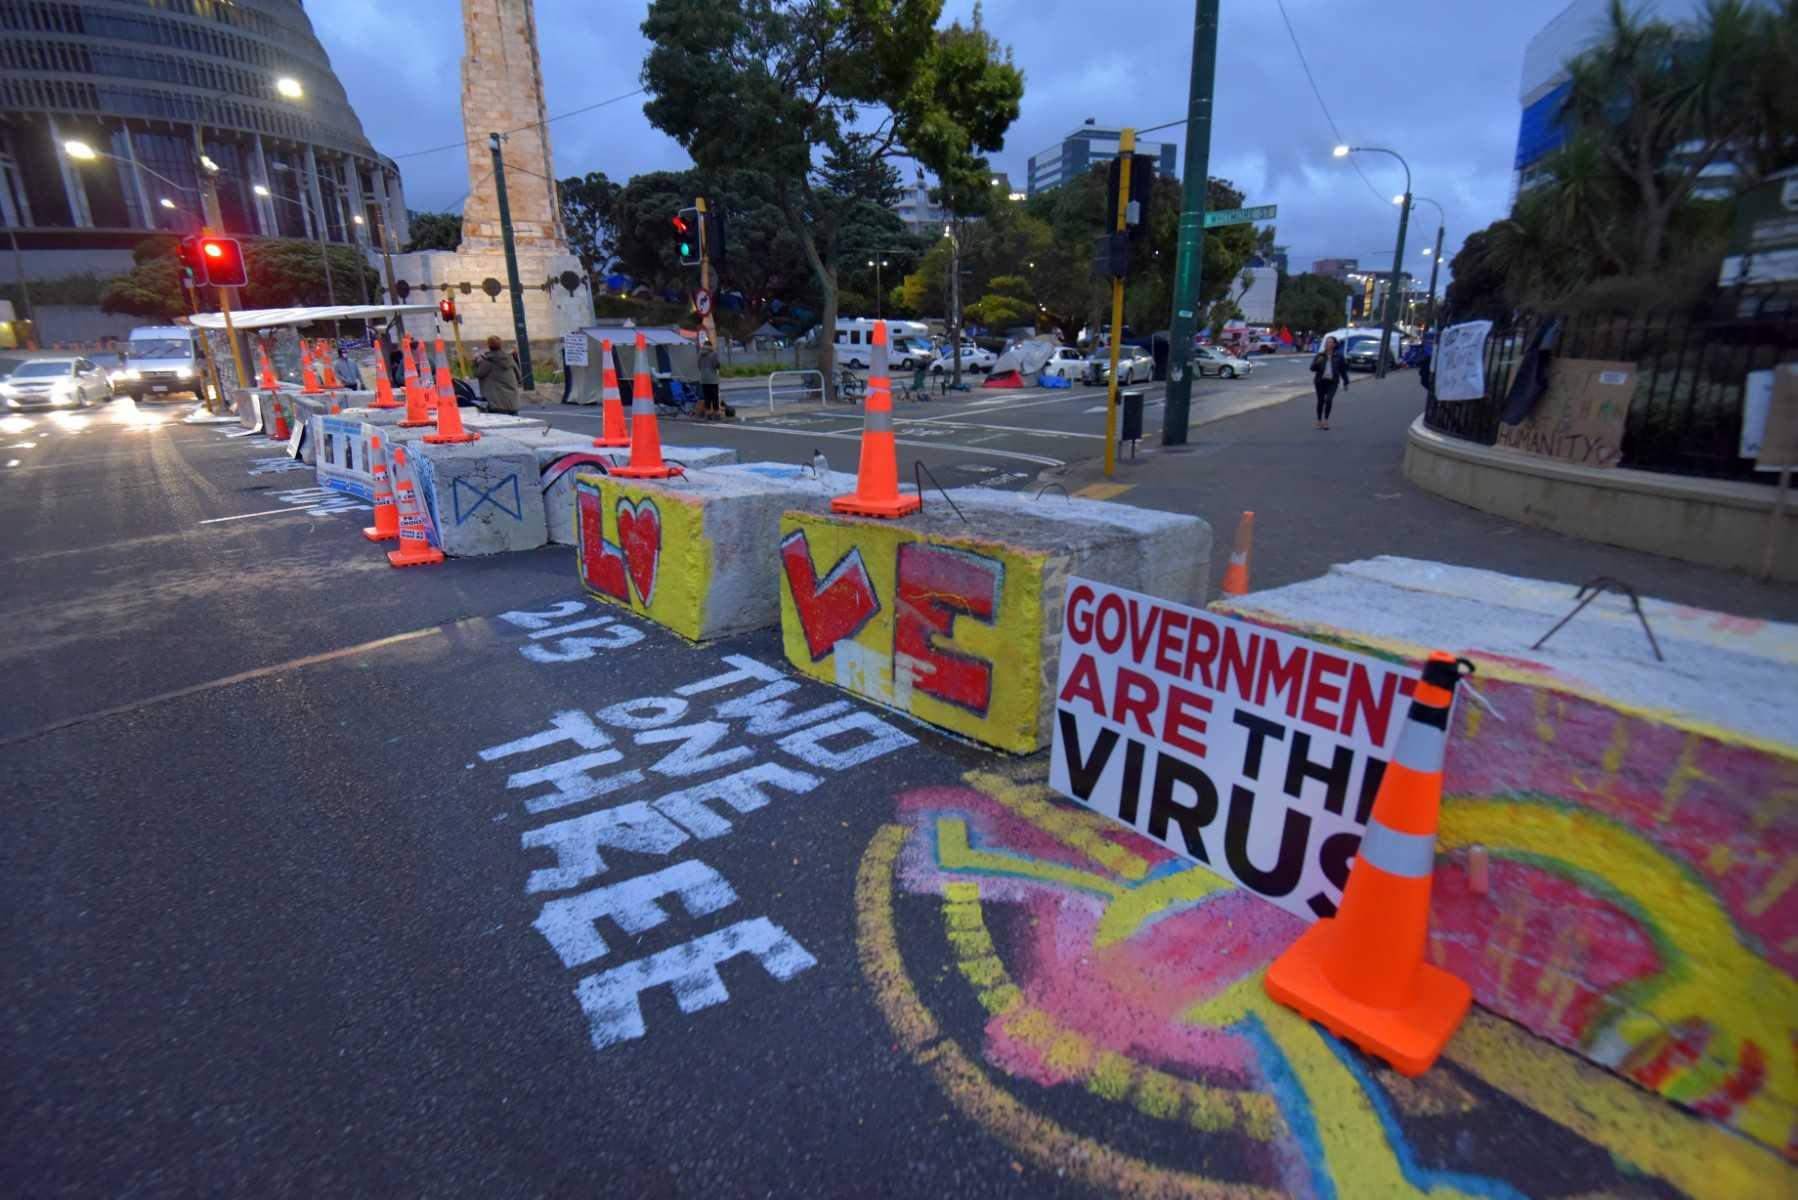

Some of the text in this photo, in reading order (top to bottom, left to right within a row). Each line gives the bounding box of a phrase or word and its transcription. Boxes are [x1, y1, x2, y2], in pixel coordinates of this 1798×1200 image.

[1500, 429, 1601, 464] HUMANITY
[674, 653, 919, 771] TWO
[1059, 653, 1213, 758] ARE
[1067, 585, 1418, 748] GOVERNMEN
[595, 696, 826, 841] ONE
[1058, 708, 1366, 919] VIRUS
[477, 709, 818, 1051] THREE
